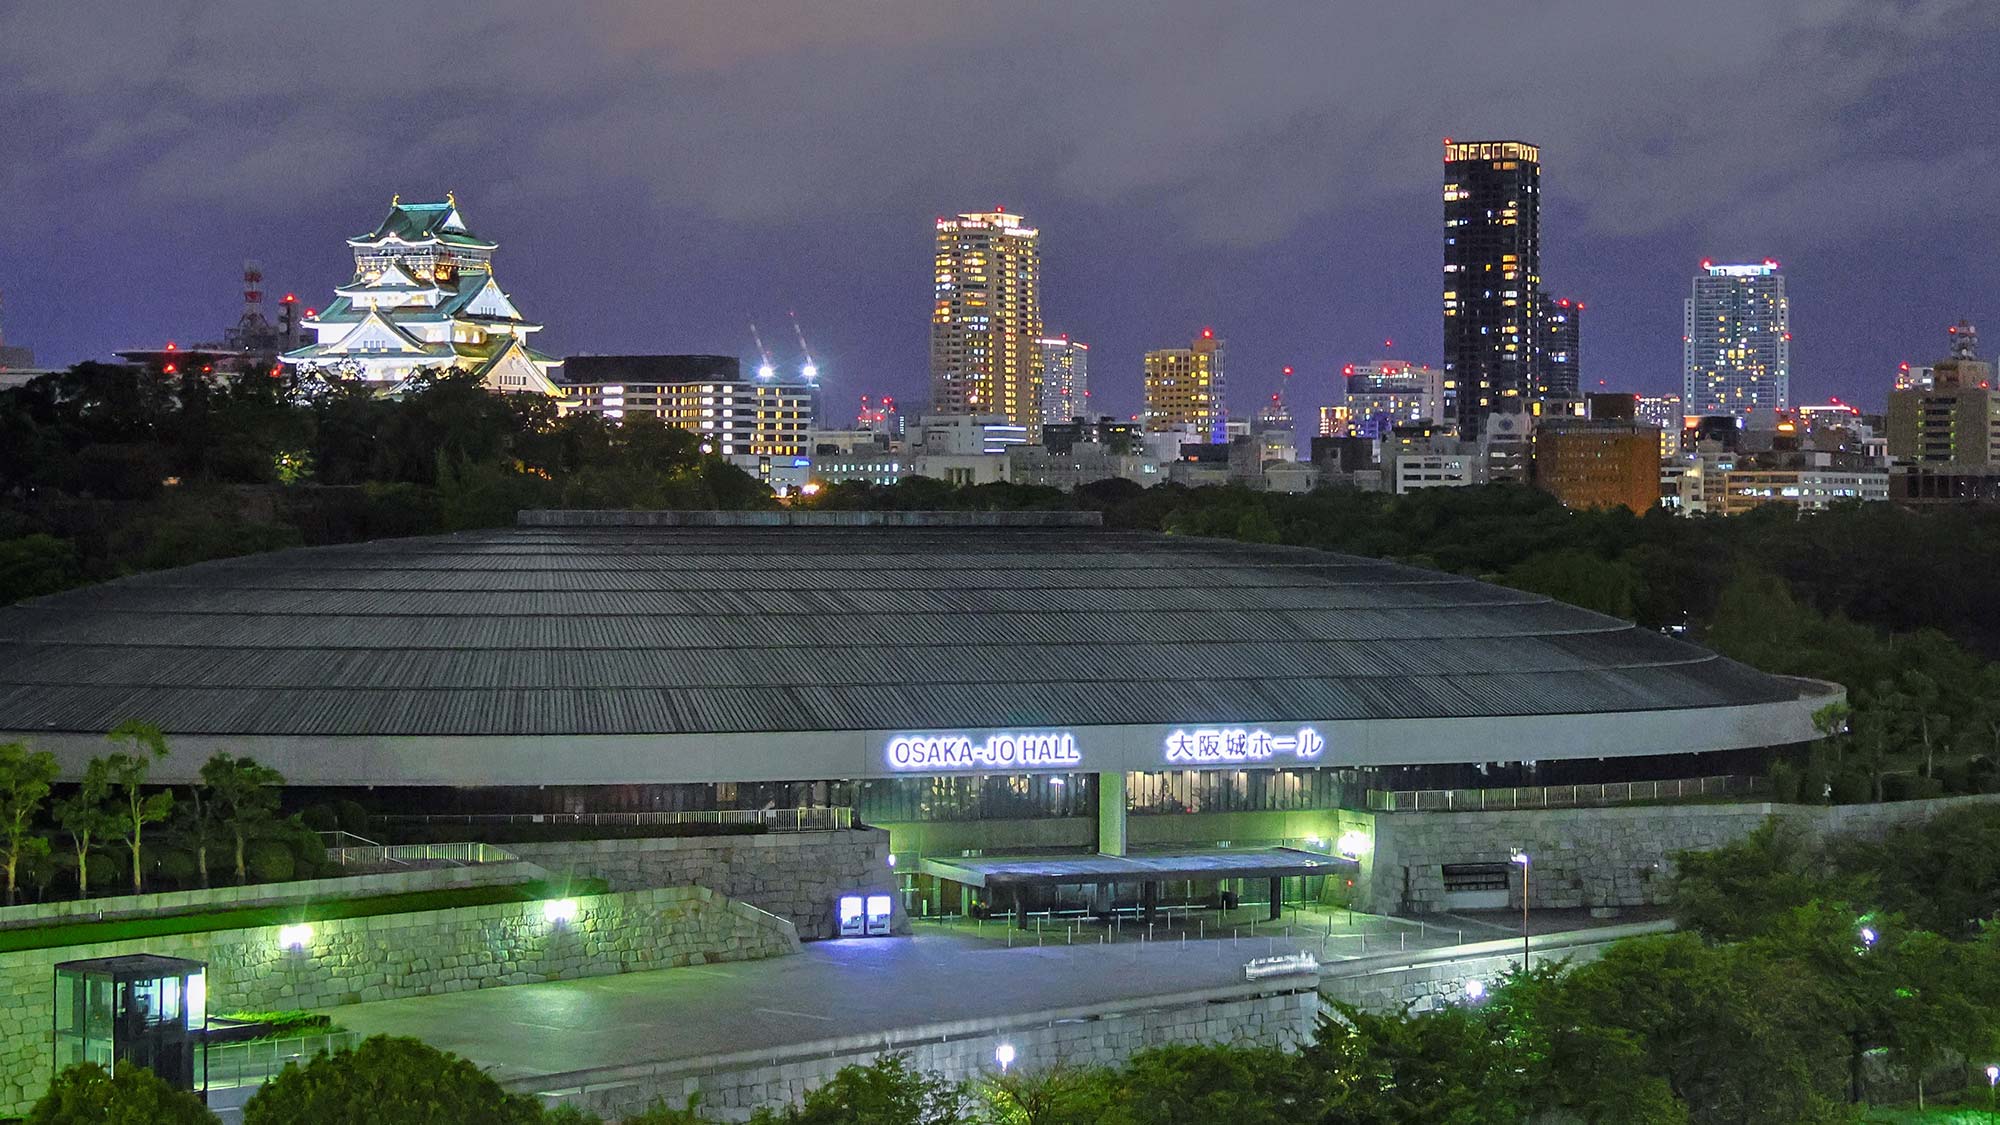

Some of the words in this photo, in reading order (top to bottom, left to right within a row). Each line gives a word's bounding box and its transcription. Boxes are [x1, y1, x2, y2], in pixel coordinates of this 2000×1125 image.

[894, 740, 1015, 764] OSAKA-JO
[1022, 738, 1079, 761] HALL
[1171, 732, 1322, 758] 大阪城ホール
